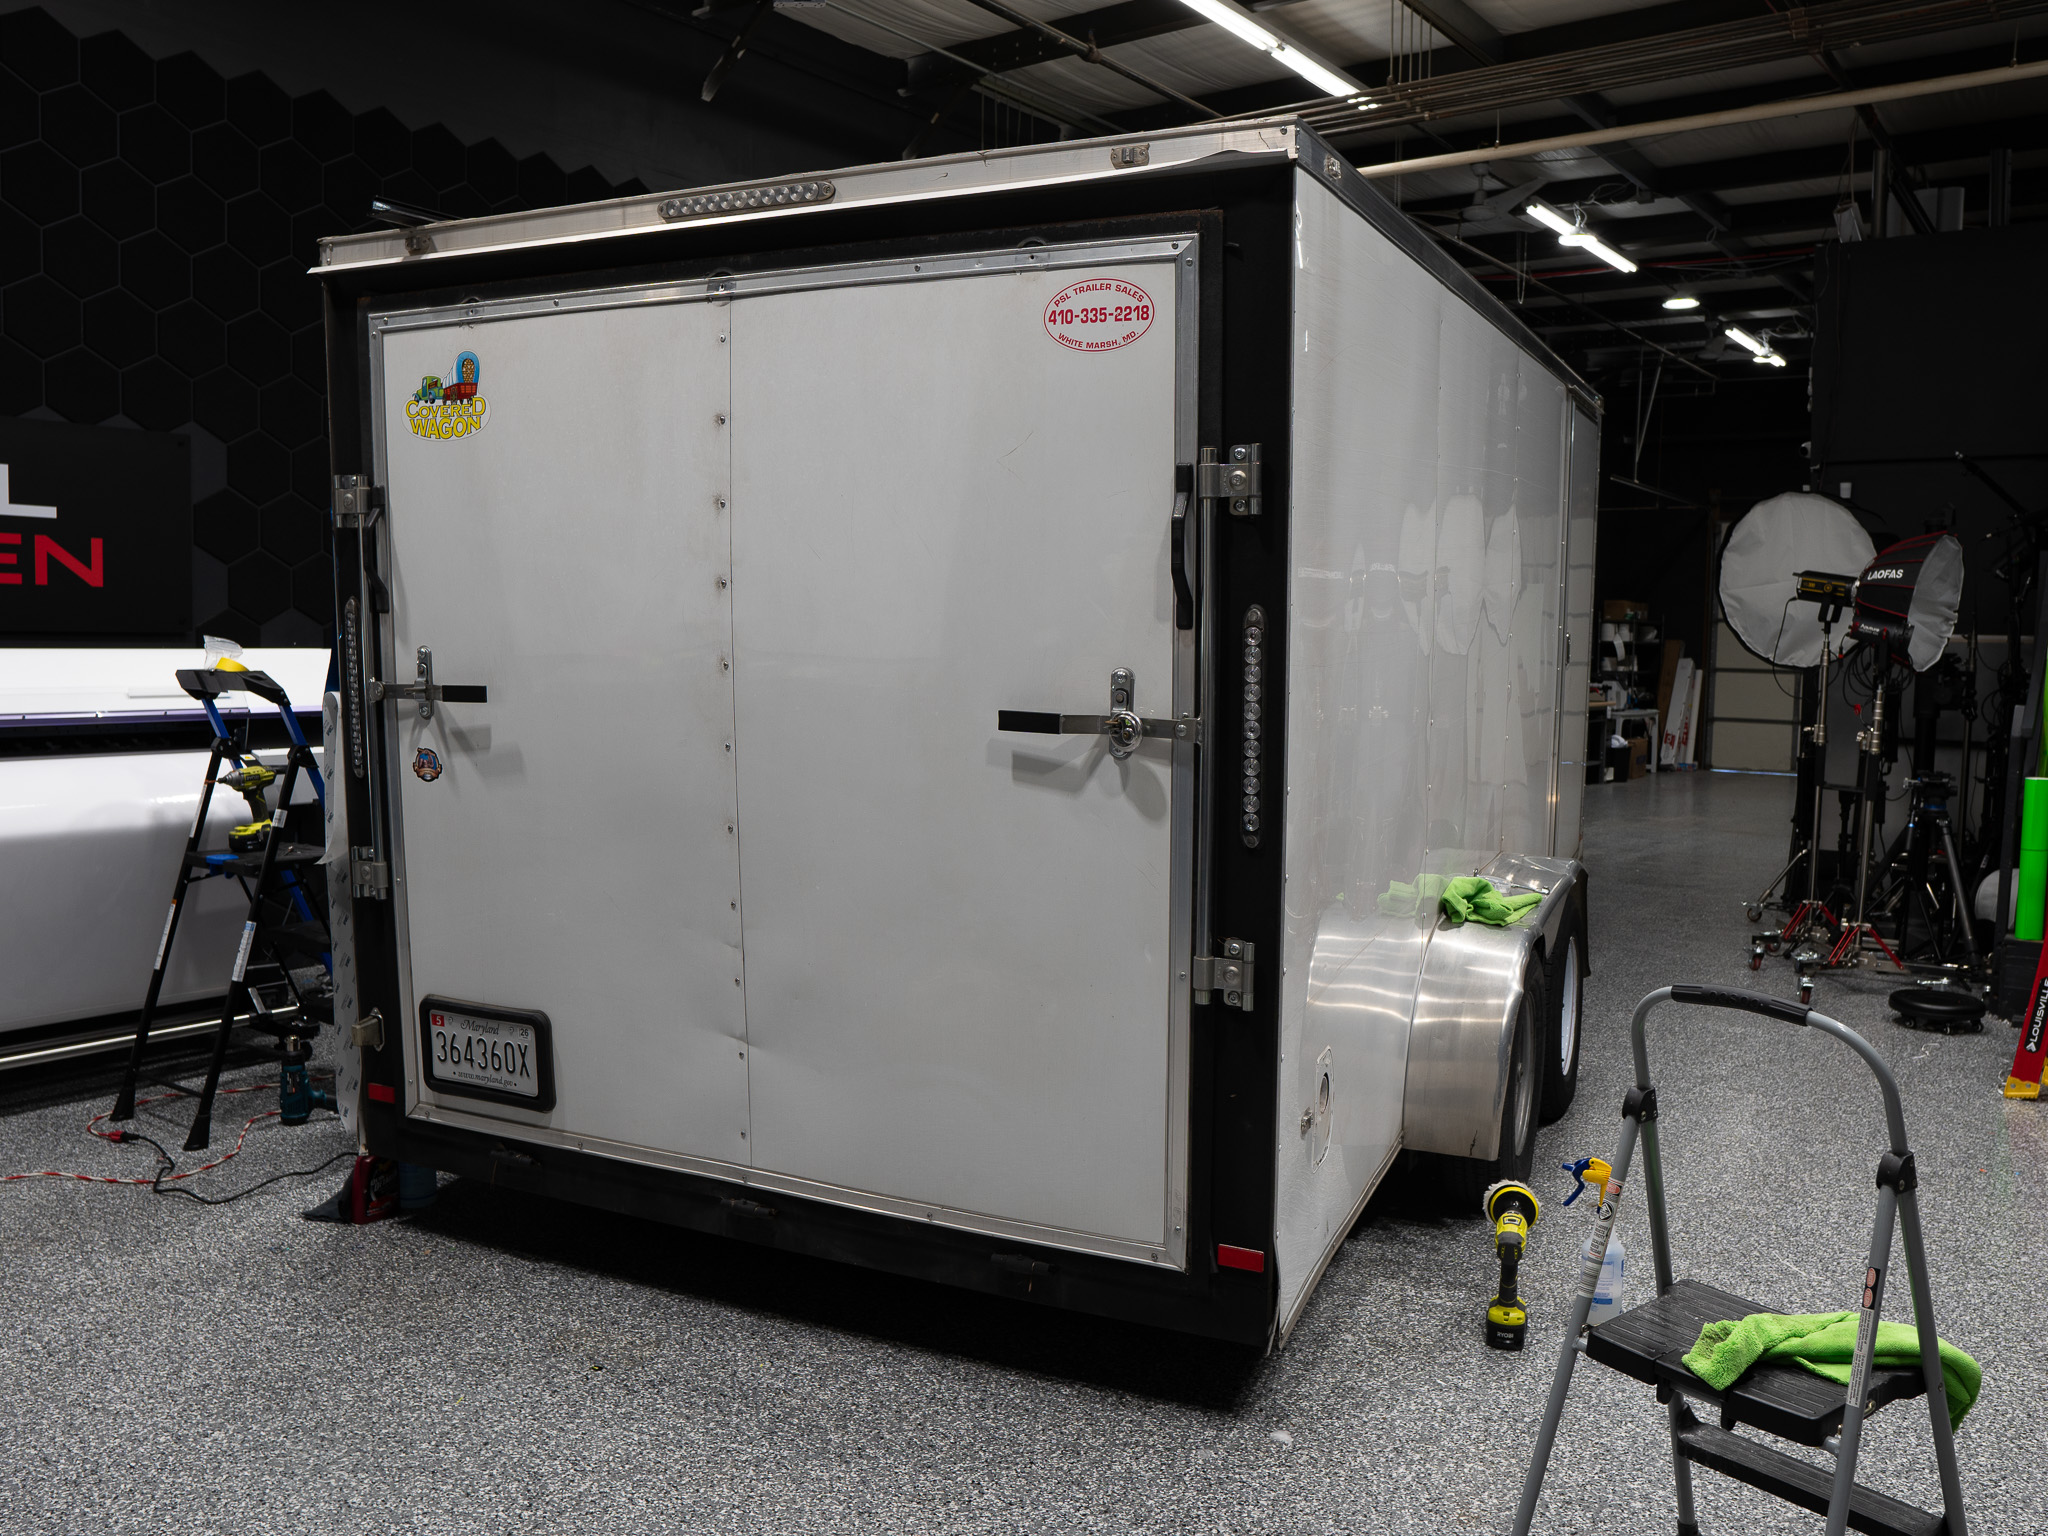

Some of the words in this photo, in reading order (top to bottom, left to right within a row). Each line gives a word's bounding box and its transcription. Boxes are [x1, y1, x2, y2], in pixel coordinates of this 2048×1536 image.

[1054, 293, 1072, 308] PSL
[1073, 283, 1112, 296] TRAILER
[1115, 284, 1145, 303] SALES
[1048, 305, 1150, 325] 410-335-2218
[1058, 332, 1084, 348] WHITE
[1122, 330, 1139, 343] MD.
[409, 416, 482, 440] WAGON
[1867, 569, 1904, 581] LAOFAS
[436, 1016, 442, 1025] 5
[461, 1019, 500, 1036] Maryland
[520, 1027, 529, 1037] 26
[436, 1030, 531, 1079] 364360X
[458, 1071, 514, 1087] www.maryland.gov
[1496, 1331, 1514, 1339] RYOBI
